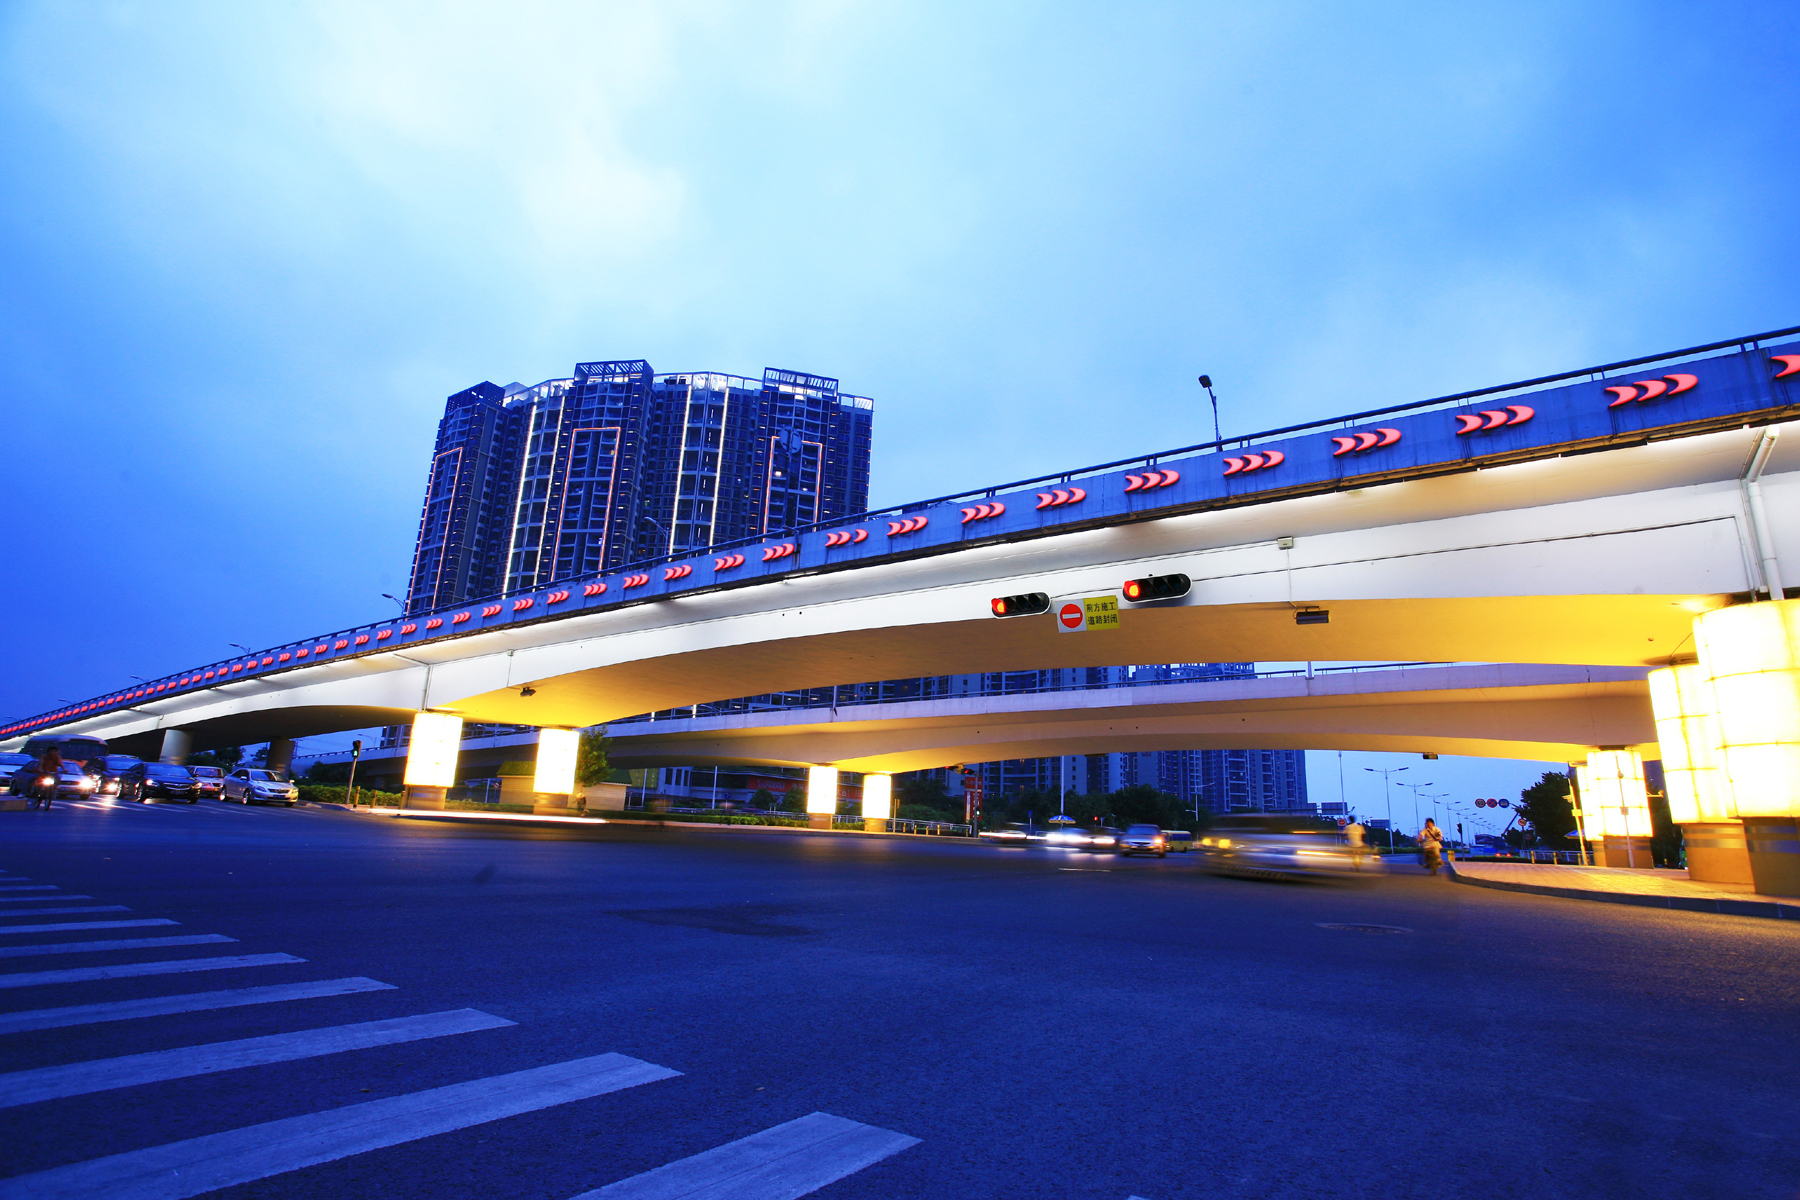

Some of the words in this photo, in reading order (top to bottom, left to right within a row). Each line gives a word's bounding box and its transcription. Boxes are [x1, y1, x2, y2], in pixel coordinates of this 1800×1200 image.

[1086, 601, 1116, 612] 前方施工
[1088, 614, 1118, 625] 道路封闭
